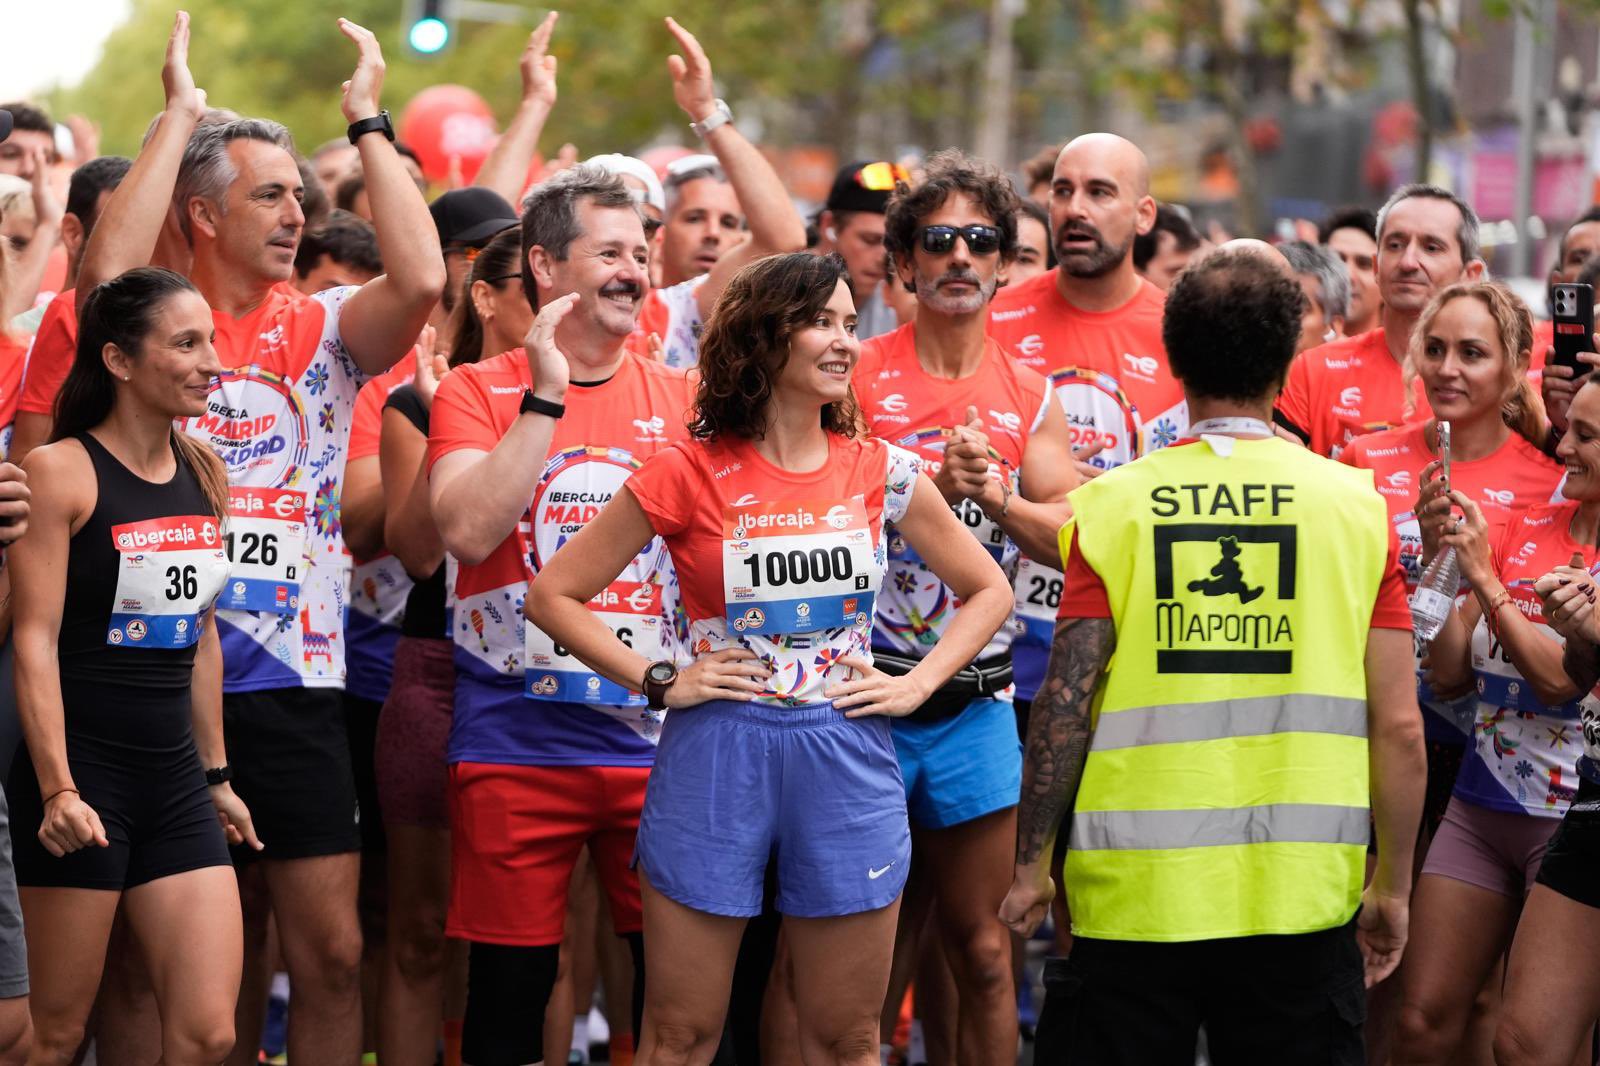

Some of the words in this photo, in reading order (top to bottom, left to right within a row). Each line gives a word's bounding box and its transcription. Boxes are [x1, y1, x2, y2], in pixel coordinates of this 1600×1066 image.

[543, 505, 600, 525] MAD
[549, 492, 612, 503] IBERCAJA
[1151, 483, 1295, 517] STAFF
[165, 564, 198, 601] 36
[743, 545, 853, 588] 10000
[1156, 602, 1293, 648] MAPOMA
